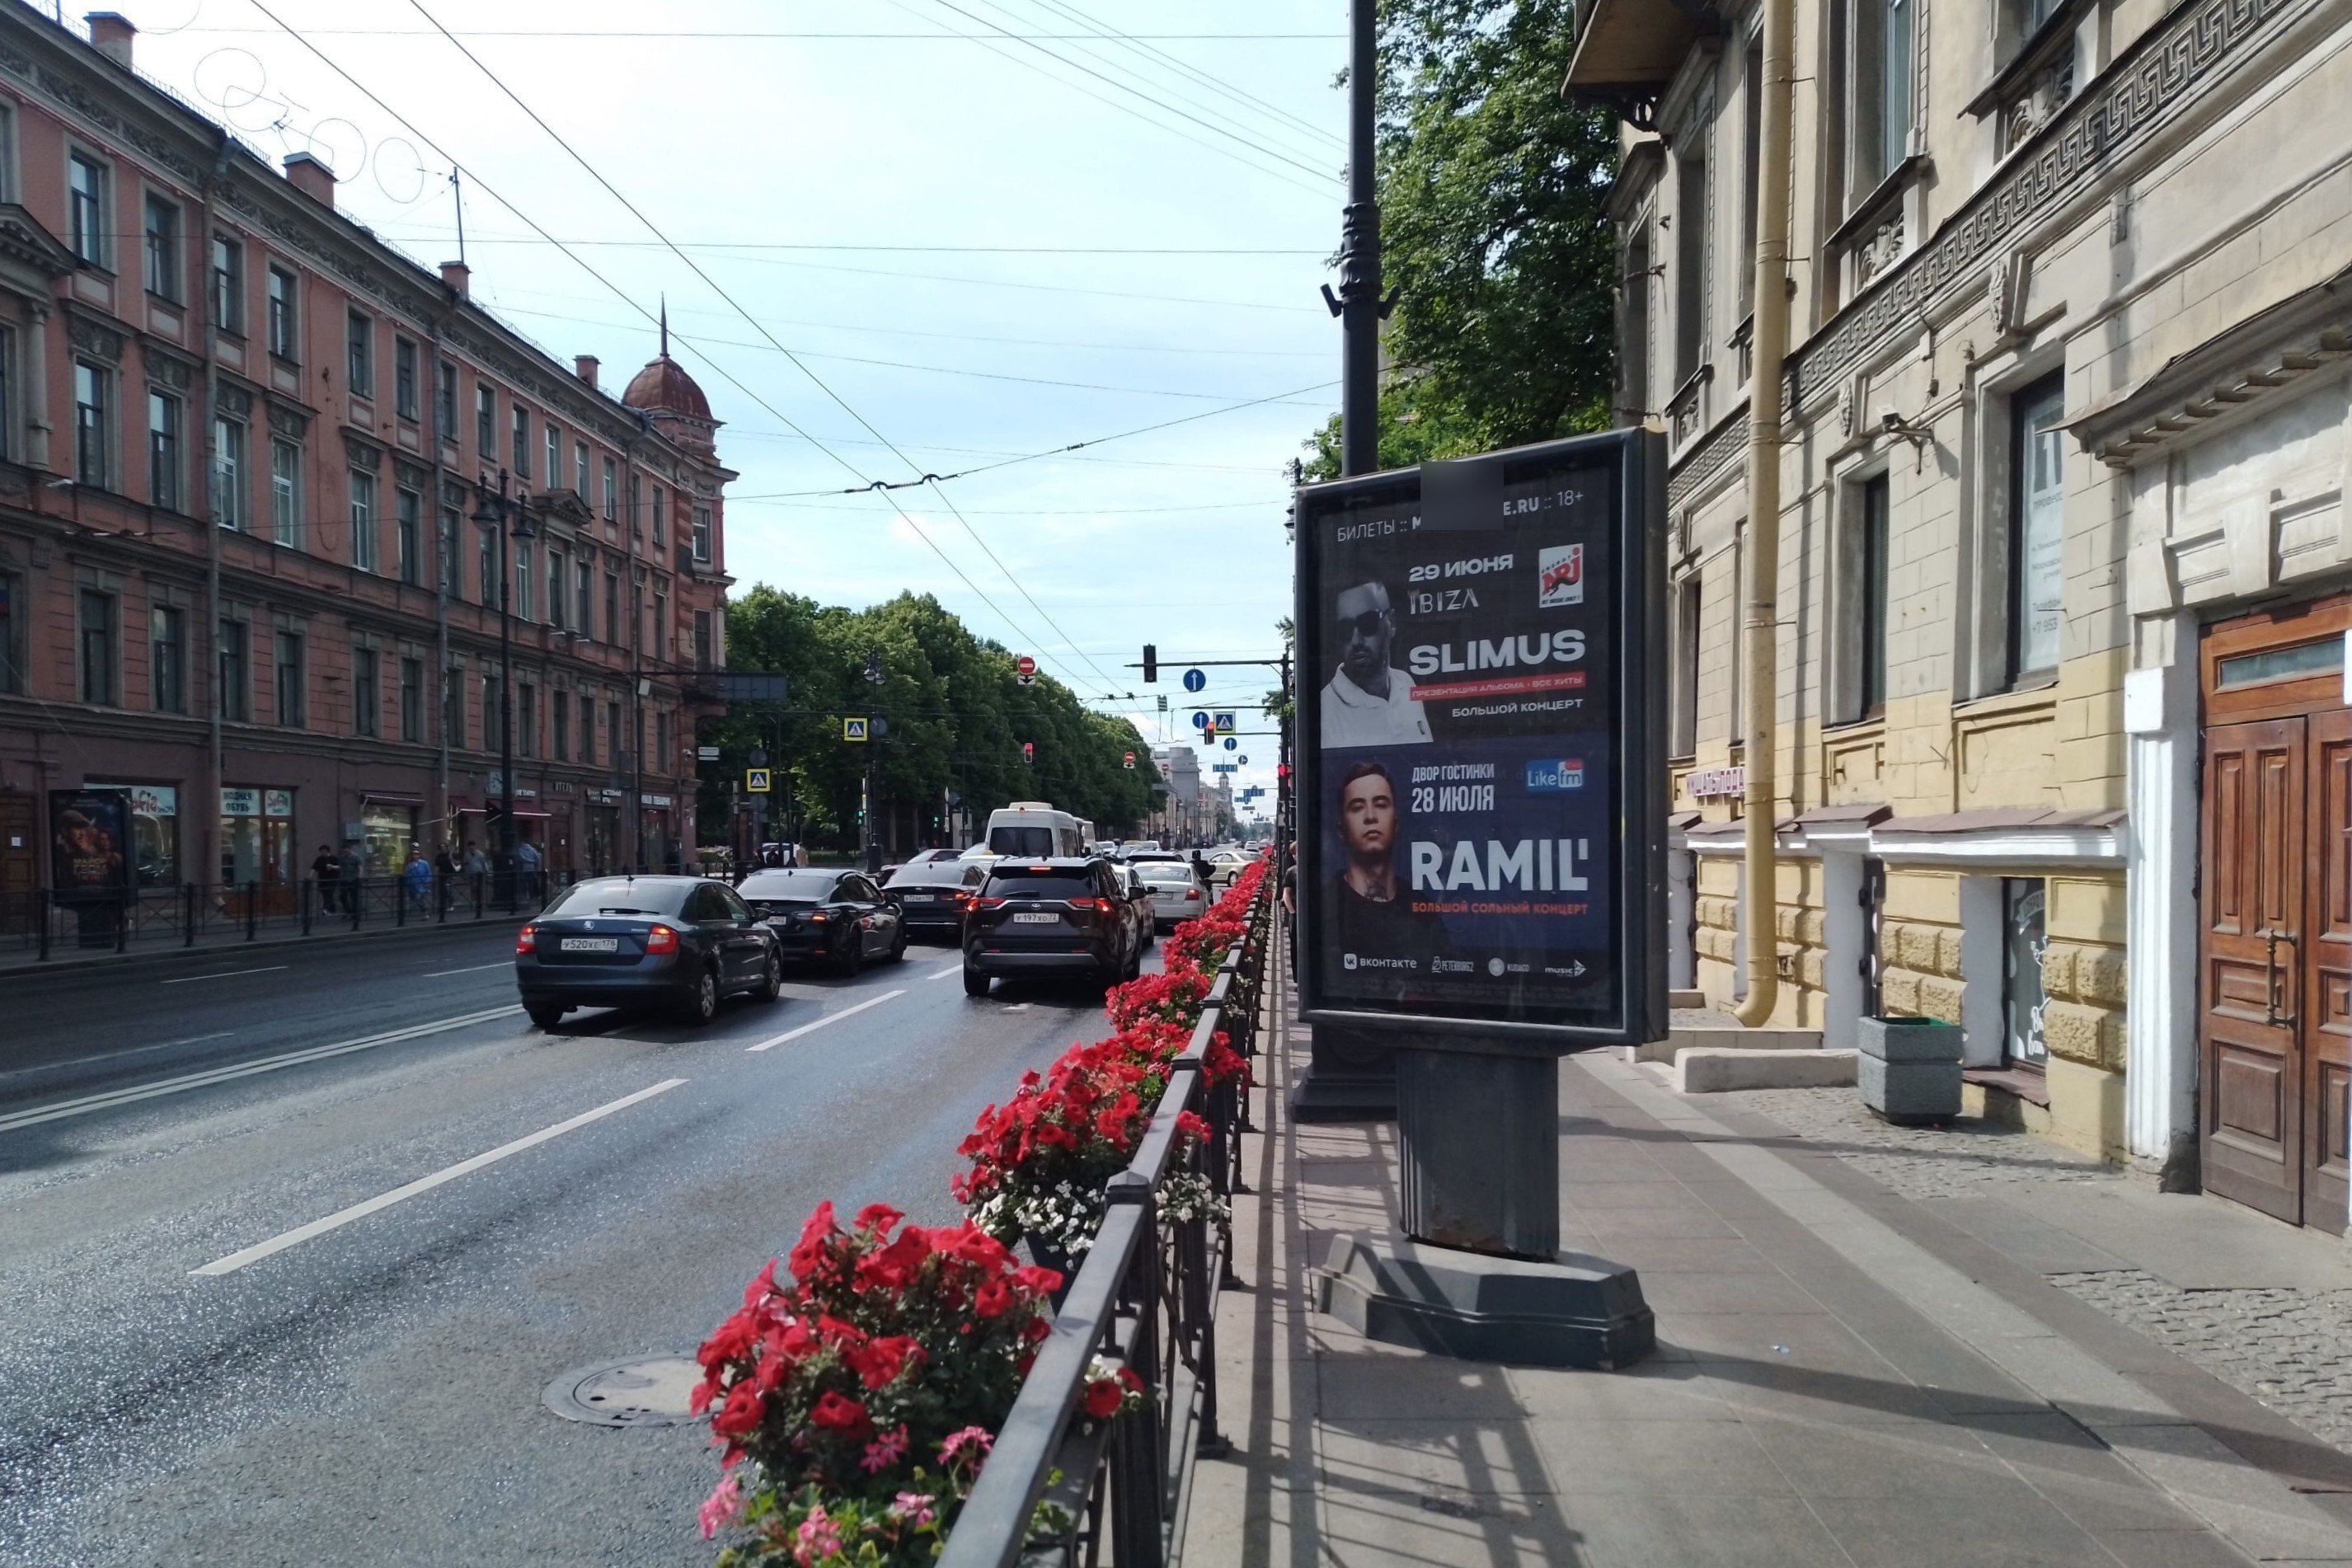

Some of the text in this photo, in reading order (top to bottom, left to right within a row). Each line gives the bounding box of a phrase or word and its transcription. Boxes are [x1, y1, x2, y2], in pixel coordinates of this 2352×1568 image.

[1337, 519, 1395, 542] БИЛЕТЫ
[1557, 490, 1584, 507] 18+
[1409, 554, 1514, 582] 29 ИЮНЯ
[1408, 588, 1480, 614] IBIZA
[1409, 629, 1586, 675] SLIMUS
[1412, 677, 1583, 697] ПРЕЗЕНТАЦИЯ АЛЬБОМА ВСЕ ХИТЫ
[1452, 698, 1584, 718] БОЛЬШОЙ КОНЦЕРТ
[1411, 763, 1495, 783] ДВОР ГОСТИНКИ
[1528, 769, 1581, 786] Like fm
[225, 802, 251, 811] ОБУВЬ
[1411, 785, 1495, 813] 28 ИЮЛЯ
[1412, 901, 1588, 915] БОЛЬШОЙ СОЛЬНЫЙ КОНЦЕРТ
